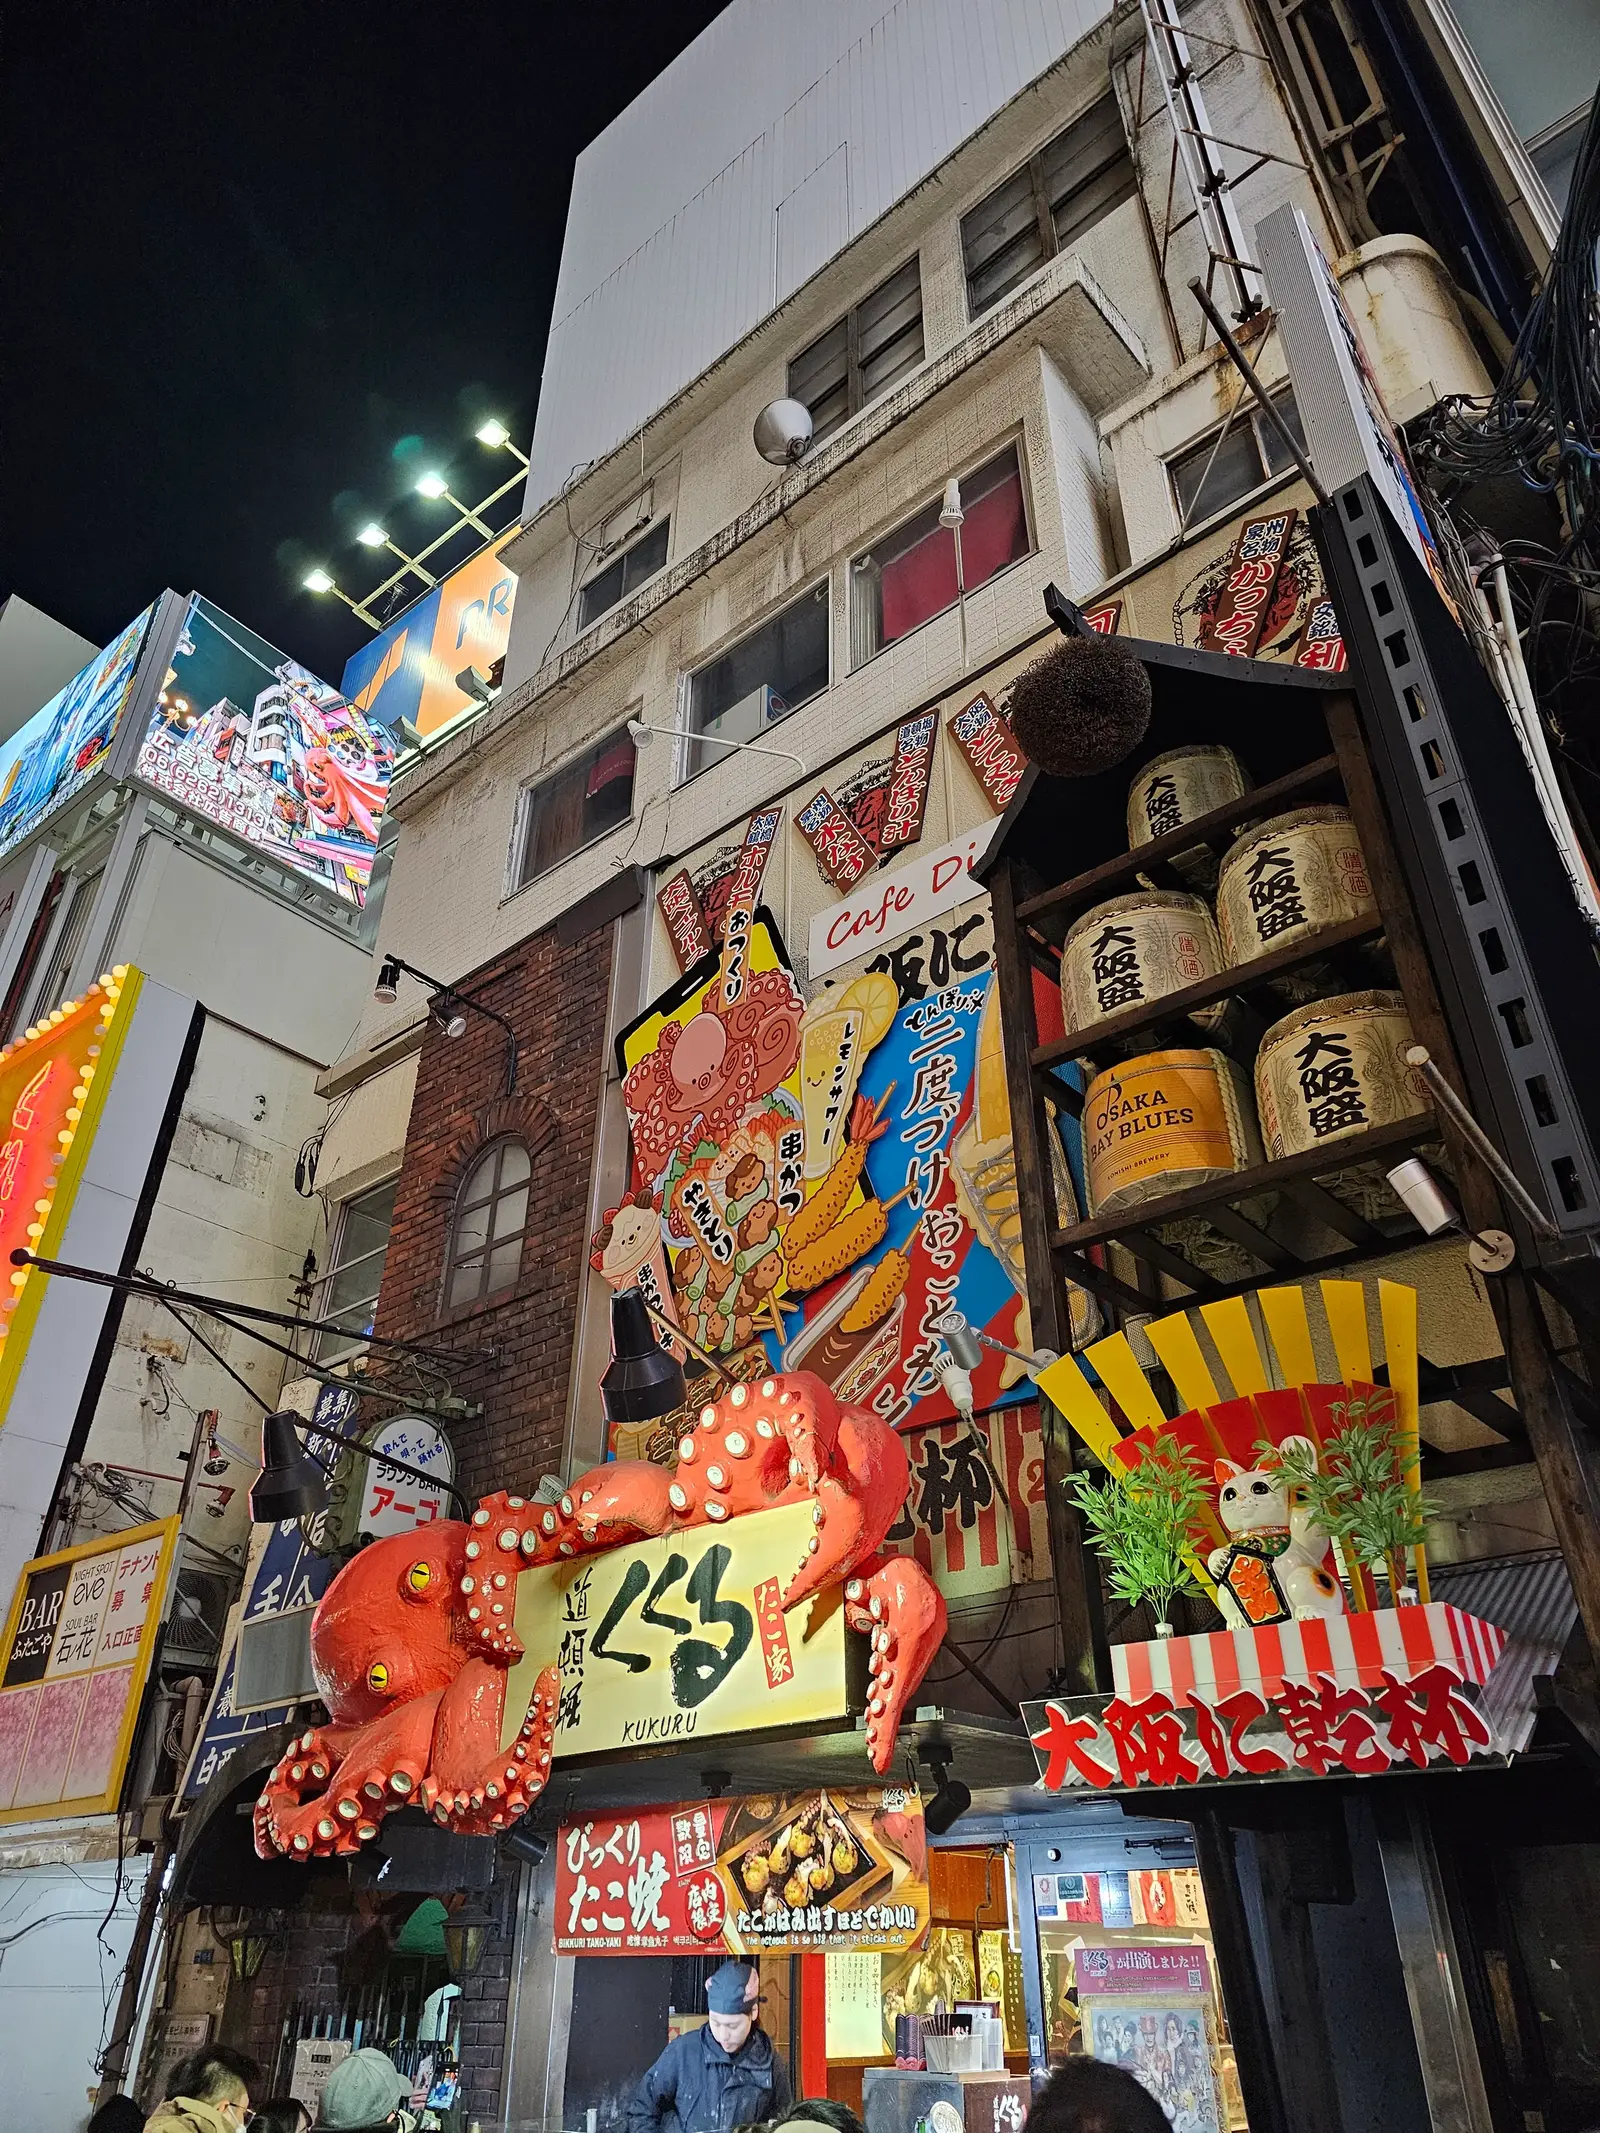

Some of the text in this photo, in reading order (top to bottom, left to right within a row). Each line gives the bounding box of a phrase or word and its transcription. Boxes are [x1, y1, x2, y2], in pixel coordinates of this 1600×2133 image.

[1240, 536, 1281, 560] 名物
[1246, 515, 1288, 541] 泉州
[150, 729, 243, 796] 広告募集
[899, 731, 932, 753] 名物
[141, 762, 262, 841] 株式会社広告商事
[145, 748, 266, 827] 06(6262)1313
[1144, 774, 1184, 838] 大阪盛
[826, 886, 915, 949] Cafe
[1245, 847, 1308, 942] 大阪盛
[724, 909, 751, 1006] おつくり
[1090, 925, 1145, 1012] 大阪盛
[820, 1021, 855, 1146] レモンサワー
[1096, 1088, 1169, 1131] OSAKA
[1294, 1032, 1370, 1138] 大阪盛
[1090, 1108, 1194, 1162] BAY BLUES
[1134, 1152, 1171, 1168] BREWERY
[779, 1128, 805, 1216] 串かつ
[681, 1181, 737, 1264] やきとり
[382, 1433, 408, 1456] 飲んで
[73, 1561, 115, 1582] NIGHT SPOT
[73, 1577, 106, 1606] eve
[119, 1550, 160, 1580] テナント
[17, 1590, 64, 1634] BAR
[64, 1613, 99, 1632] SOUL BAR
[590, 1544, 754, 1709] くくる
[758, 1583, 793, 1684] たこ家
[10, 1632, 53, 1660] ふたごや
[56, 1626, 97, 1665] 石花
[555, 1567, 593, 1735] 道頓堀
[622, 1711, 697, 1742] KUKURU
[1031, 1661, 1491, 1792] 大阪に乾杯
[566, 1820, 642, 1874] びっくり
[568, 1850, 671, 1934] たこ焼
[737, 1903, 917, 1933] たこがはみ出すほどでかい!
[587, 1937, 622, 1949] TAKO-YAKI
[760, 1934, 787, 1946] octopus
[791, 1933, 799, 1945] is
[802, 1935, 811, 1945] so
[813, 1933, 826, 1946] big
[829, 1933, 846, 1945] that
[861, 1933, 887, 1944] sticks
[890, 1932, 907, 1945] out.
